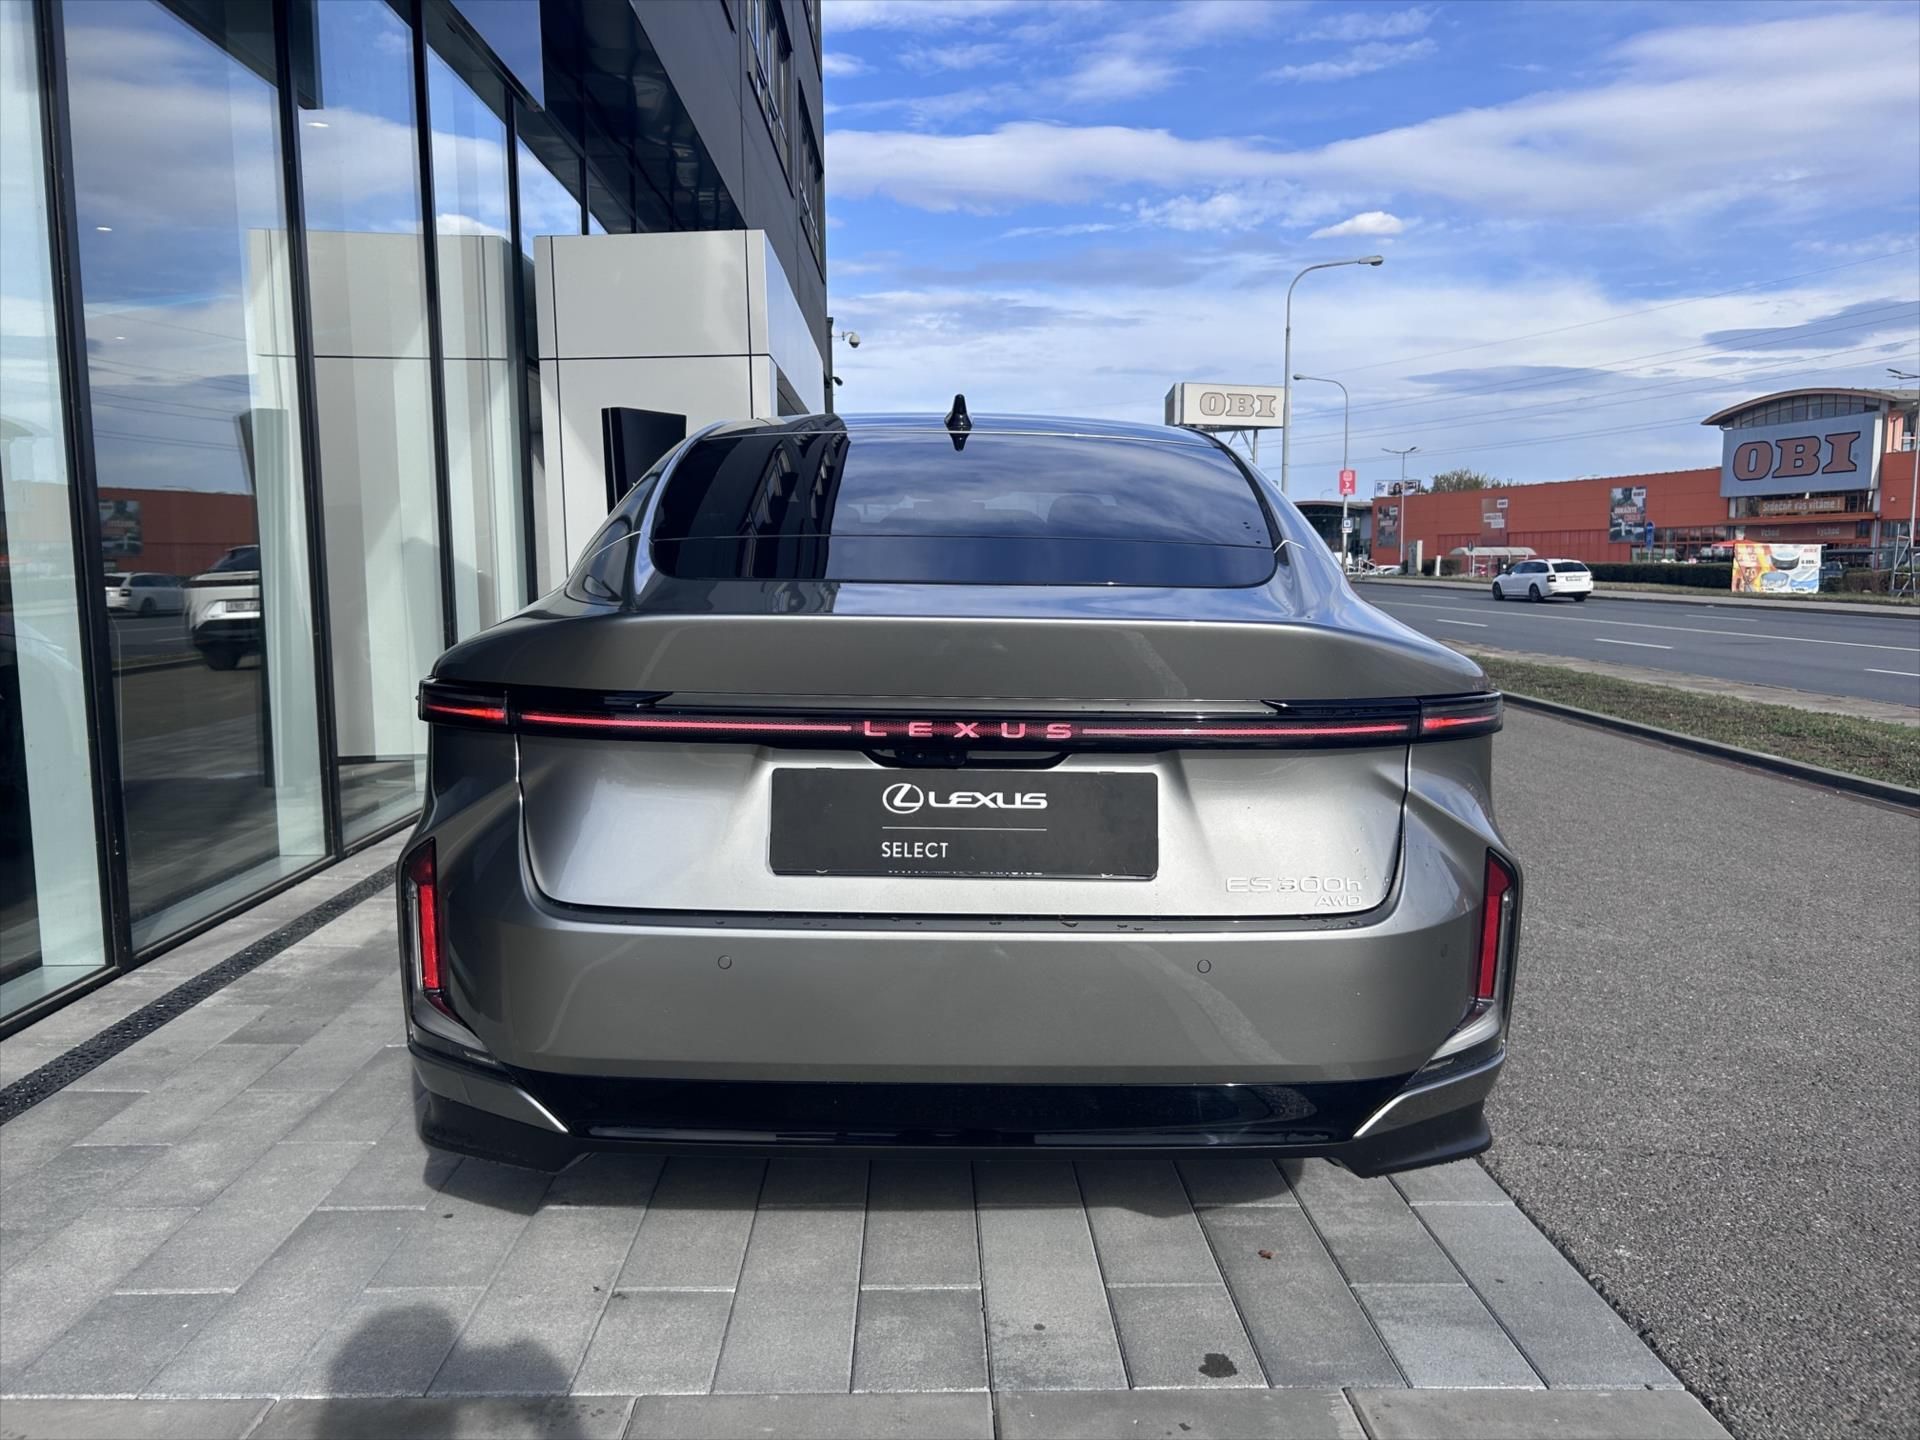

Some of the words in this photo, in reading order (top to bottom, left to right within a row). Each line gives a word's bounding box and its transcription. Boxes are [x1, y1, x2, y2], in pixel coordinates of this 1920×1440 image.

[1200, 391, 1276, 417] OBI
[1733, 431, 1861, 481] OBI
[863, 720, 1072, 739] LEXUS
[928, 791, 1048, 809] LEXUS
[881, 841, 949, 859] SELECT
[1226, 876, 1272, 893] ES
[1277, 876, 1362, 893] 300h
[1315, 895, 1362, 907] AWD
